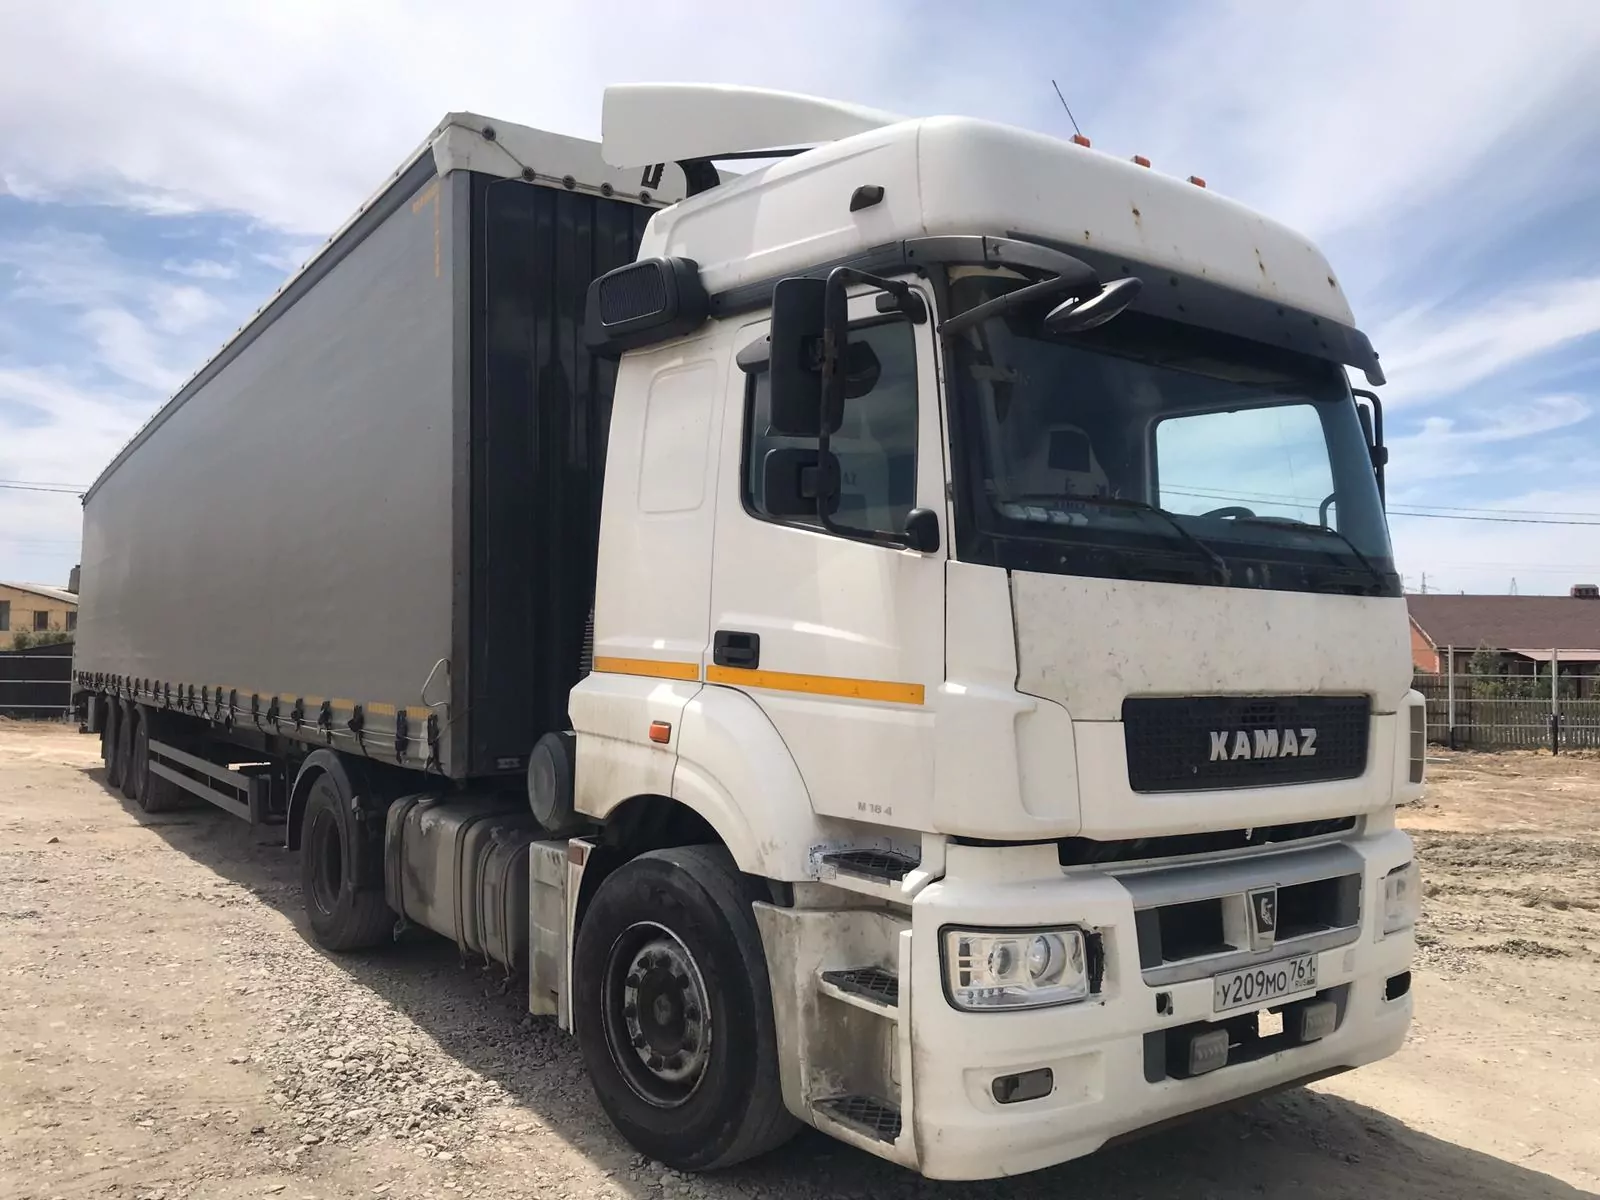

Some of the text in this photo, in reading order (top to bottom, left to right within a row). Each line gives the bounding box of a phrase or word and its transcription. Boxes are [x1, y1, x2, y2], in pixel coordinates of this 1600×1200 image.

[1209, 728, 1317, 761] KAMAZ
[1222, 957, 1313, 1006] У209МО 761
